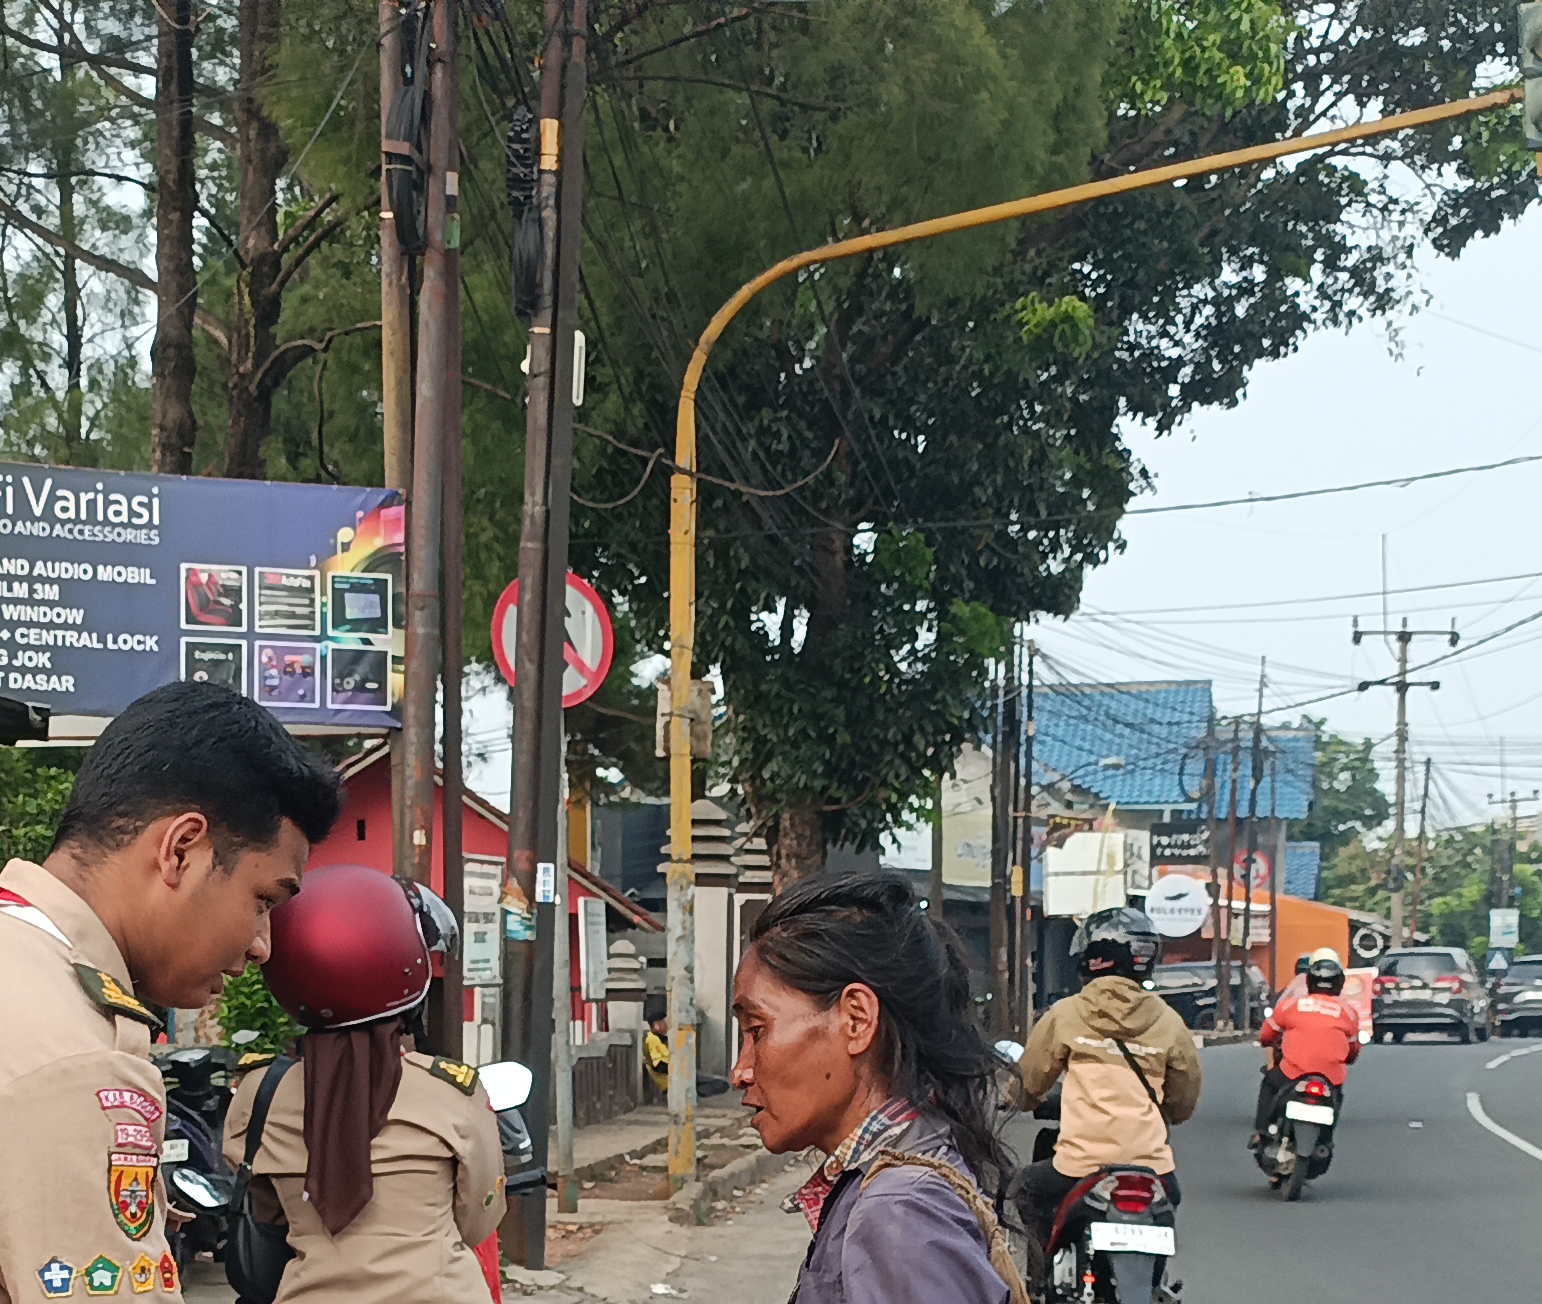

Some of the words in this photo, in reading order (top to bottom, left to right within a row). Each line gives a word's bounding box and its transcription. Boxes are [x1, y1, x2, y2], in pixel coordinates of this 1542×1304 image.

[22, 475, 161, 526] Variasi
[13, 520, 51, 538] AND
[52, 523, 160, 546] ACCESSORIES
[32, 560, 94, 581] AUDIO
[97, 564, 157, 586] MOBIL
[32, 583, 60, 601] 3M
[0, 604, 85, 625] WINDOW
[14, 627, 103, 650] CENTRAL
[106, 633, 160, 652] LOCK
[11, 650, 52, 669] JOK
[8, 672, 75, 692] DASAR
